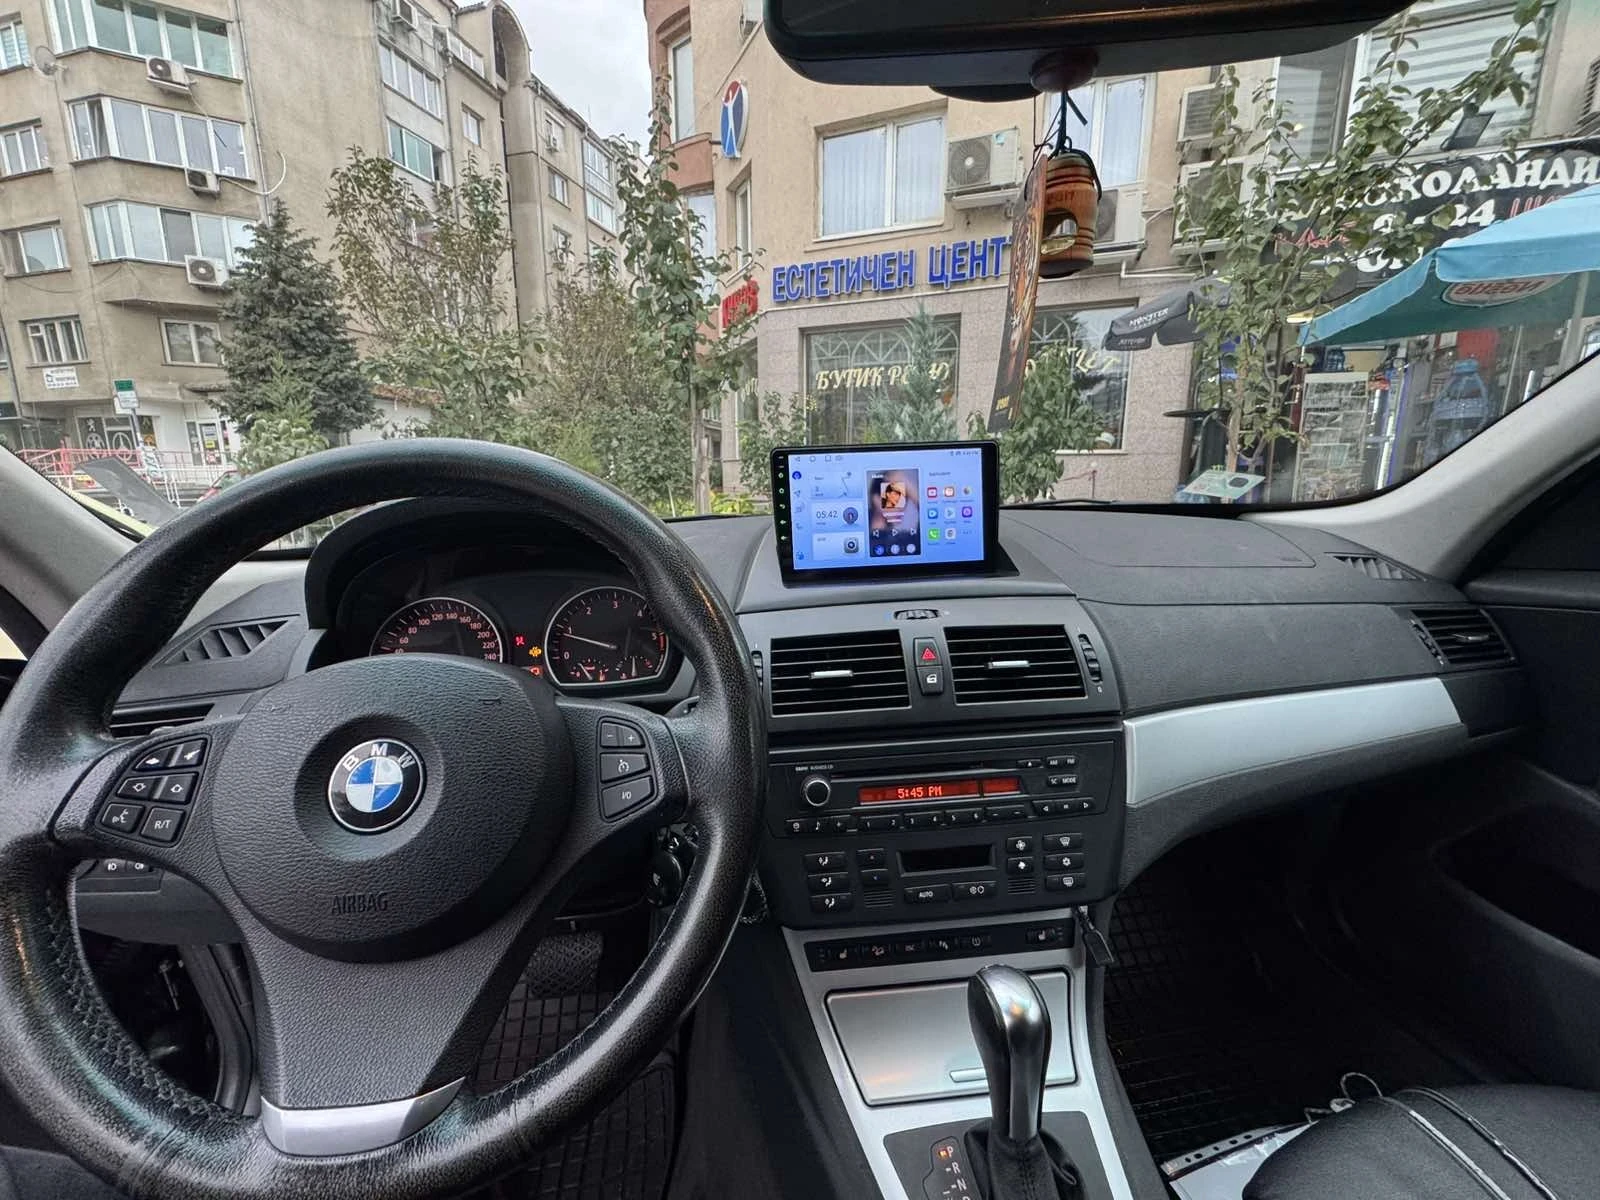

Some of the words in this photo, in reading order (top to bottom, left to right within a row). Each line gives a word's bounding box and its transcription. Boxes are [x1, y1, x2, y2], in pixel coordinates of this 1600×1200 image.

[772, 250, 915, 302] ЕСТЕТИЧЕН
[928, 236, 1012, 290] ЦЕНТ
[815, 366, 884, 390] БУТИК
[816, 510, 838, 519] 05:42
[343, 743, 415, 771] BMW
[897, 786, 924, 799] 5:45
[928, 785, 942, 796] PM
[154, 819, 172, 830] R/T
[331, 892, 389, 915] AIRBAG
[946, 1145, 953, 1157] P
[951, 1161, 960, 1174] R
[956, 1178, 967, 1191] N
